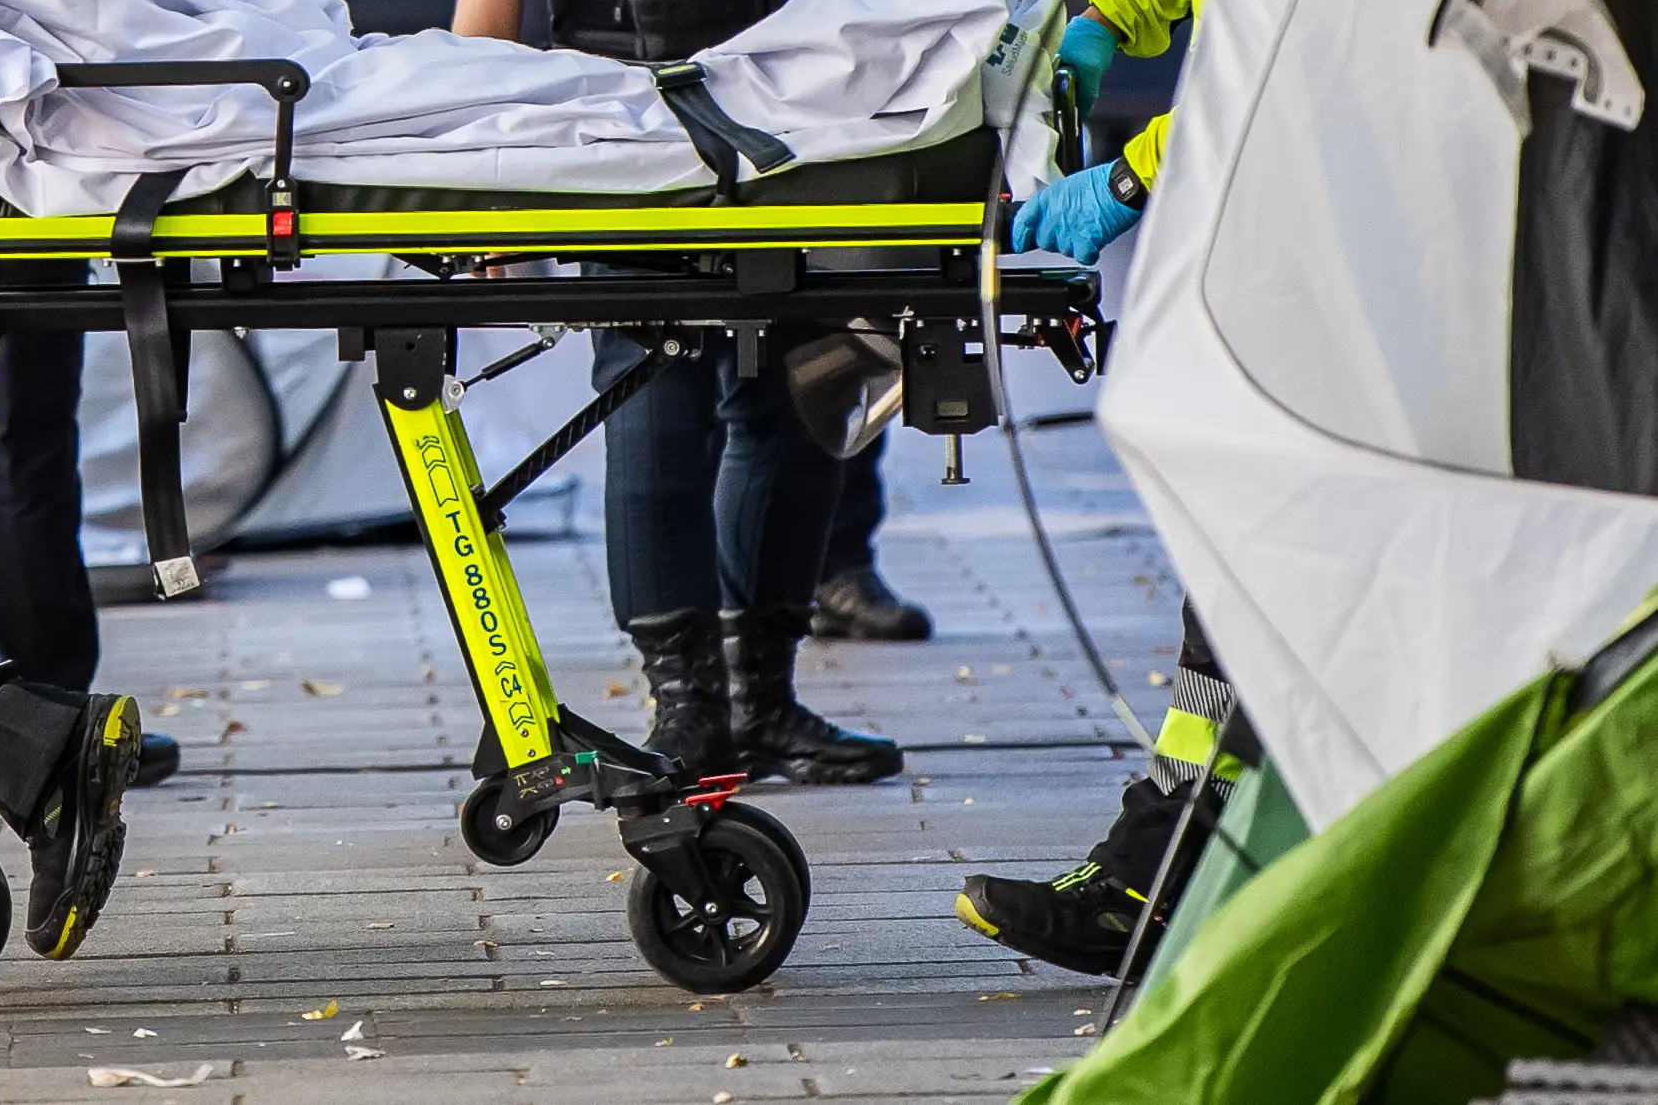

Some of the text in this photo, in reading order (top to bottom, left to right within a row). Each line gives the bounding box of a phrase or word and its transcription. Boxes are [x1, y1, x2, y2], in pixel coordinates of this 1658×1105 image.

[445, 510, 507, 656] TG 880S
[499, 674, 523, 698] C4
